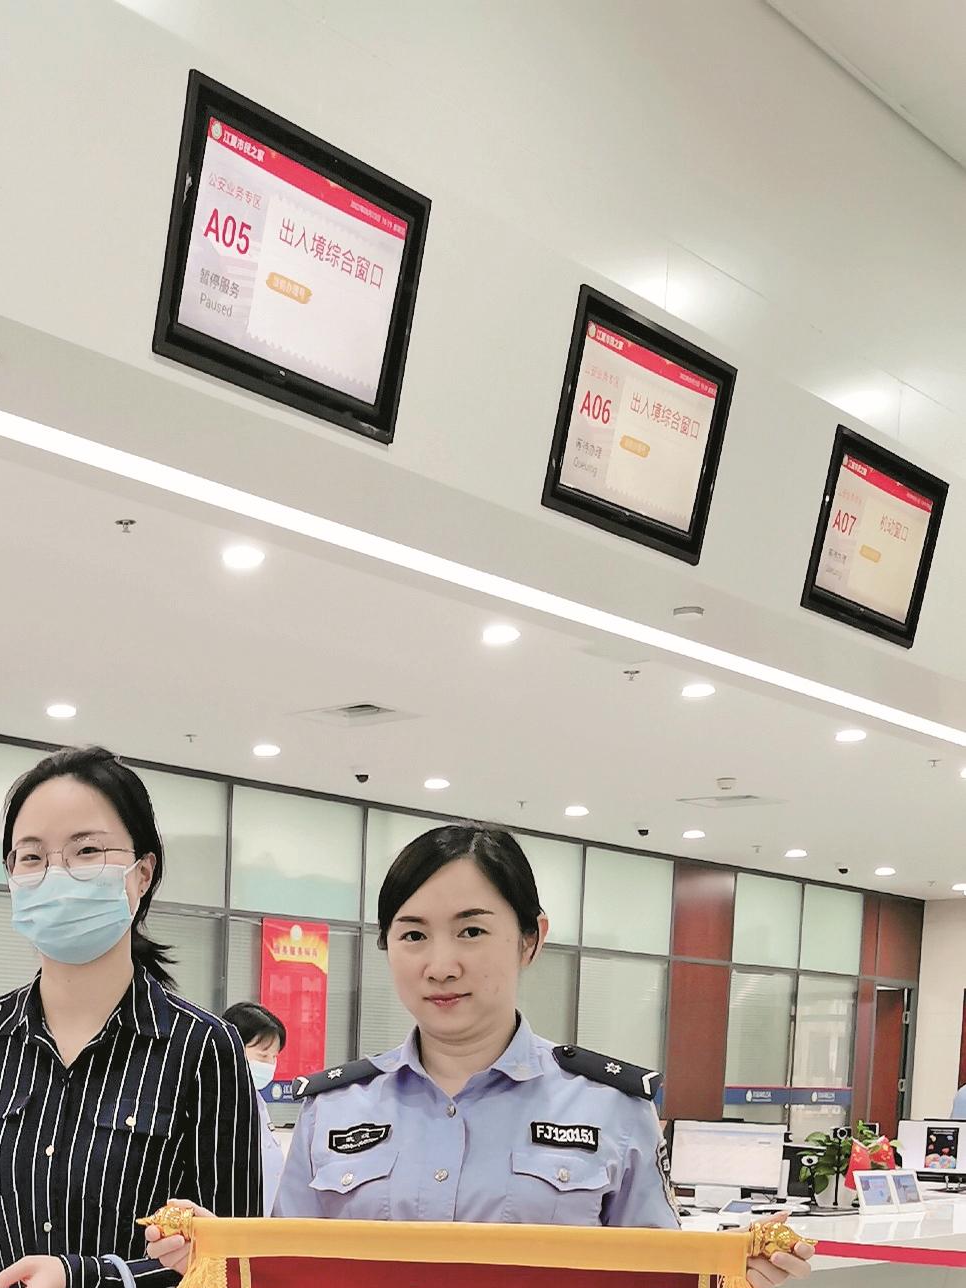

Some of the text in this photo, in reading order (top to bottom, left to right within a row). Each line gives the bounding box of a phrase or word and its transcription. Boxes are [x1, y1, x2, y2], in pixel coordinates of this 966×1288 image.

[203, 208, 252, 255] A05
[278, 217, 384, 289] 出入境综合窗口
[199, 267, 240, 299] 暂停服务
[199, 294, 233, 317] Paused
[580, 390, 612, 425] A06
[629, 391, 701, 439] 出入境综合窗口
[832, 509, 857, 536] A07
[536, 1125, 596, 1145] FJ120151
